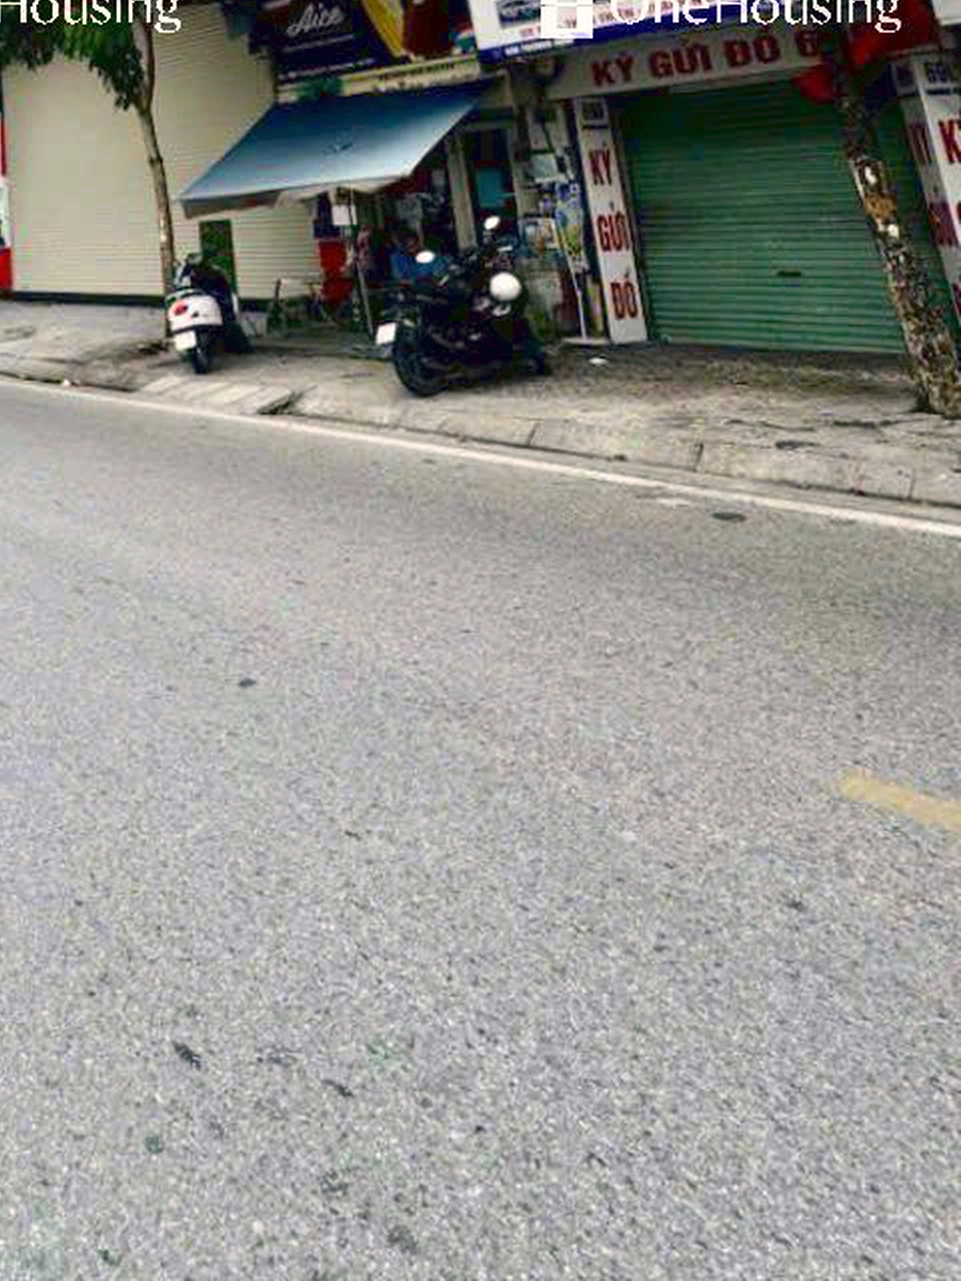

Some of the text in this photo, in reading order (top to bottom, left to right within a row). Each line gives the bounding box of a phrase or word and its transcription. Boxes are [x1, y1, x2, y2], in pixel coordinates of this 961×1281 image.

[591, 50, 634, 89] KÝ
[648, 38, 714, 78] GỬI
[588, 141, 613, 186] KÝ
